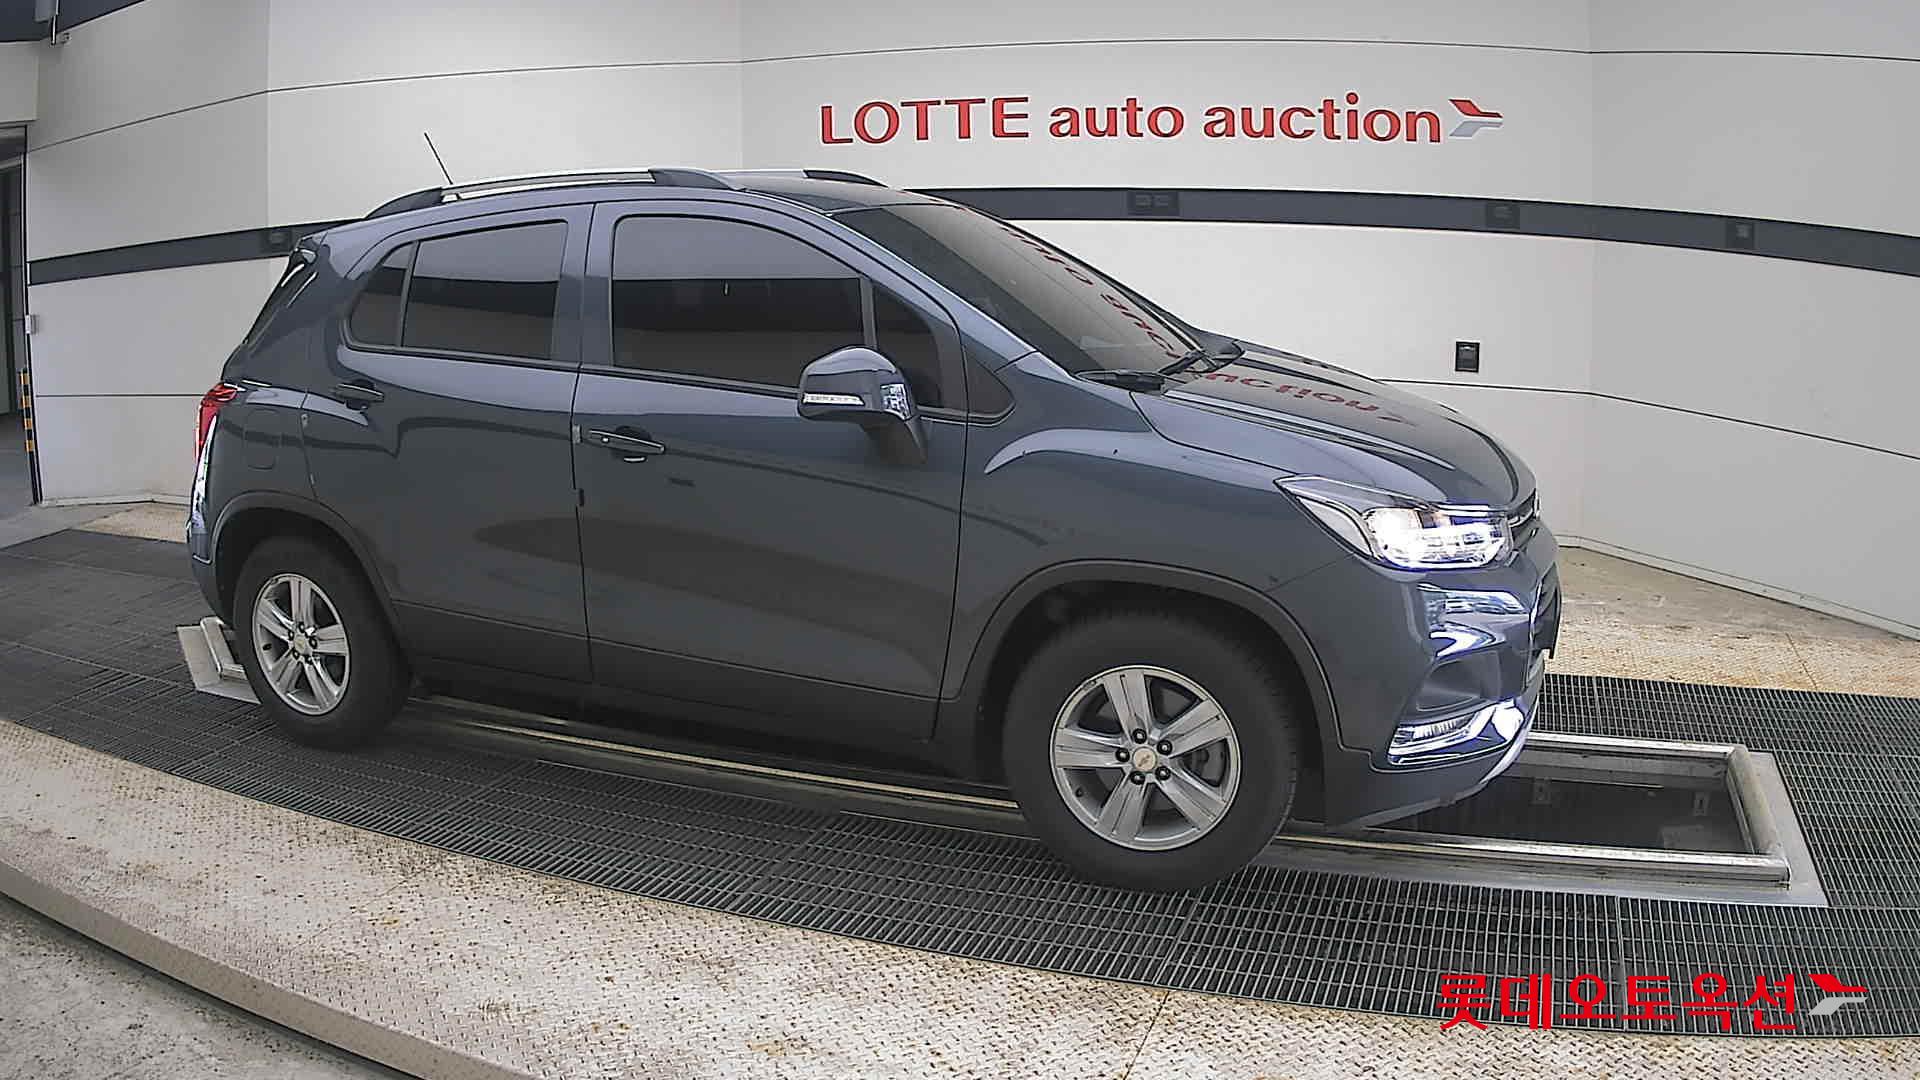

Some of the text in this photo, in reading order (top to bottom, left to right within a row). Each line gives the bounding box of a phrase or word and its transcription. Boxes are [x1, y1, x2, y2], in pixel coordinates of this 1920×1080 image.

[819, 92, 1442, 144] LOTTE auto auction
